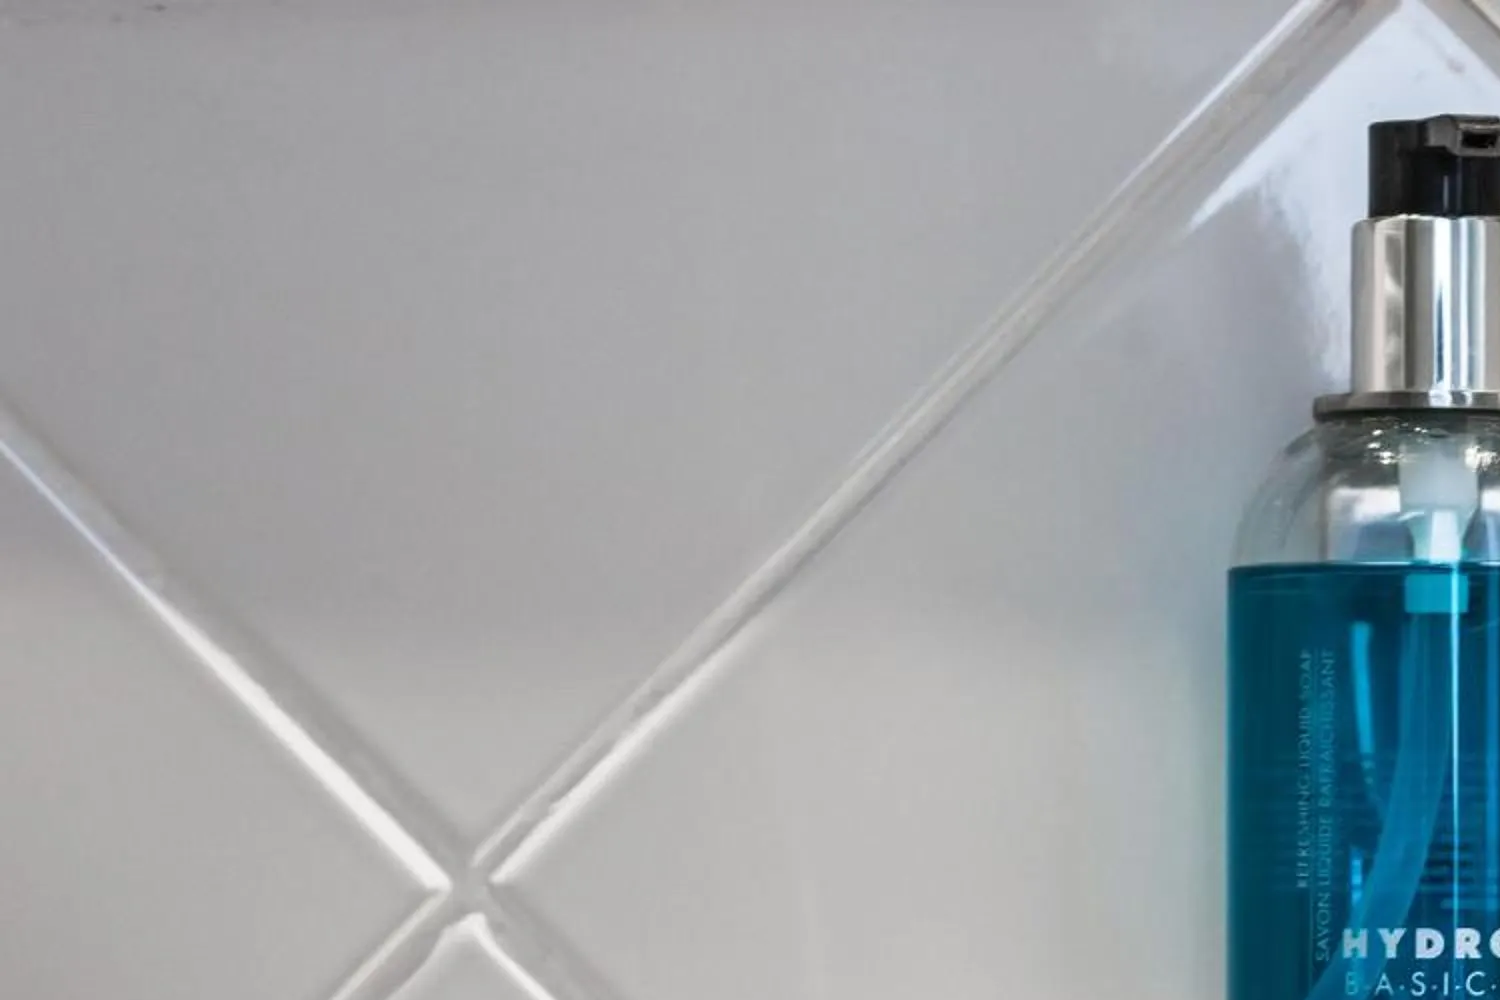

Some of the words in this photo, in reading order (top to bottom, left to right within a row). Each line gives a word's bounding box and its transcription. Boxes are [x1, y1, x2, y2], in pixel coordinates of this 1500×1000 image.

[1298, 648, 1312, 701] SOAP
[1297, 707, 1312, 767] LIQUID
[1296, 773, 1311, 889] REFRESHING
[1317, 815, 1333, 886] LIQUIDE
[1315, 892, 1332, 962] SAVON
